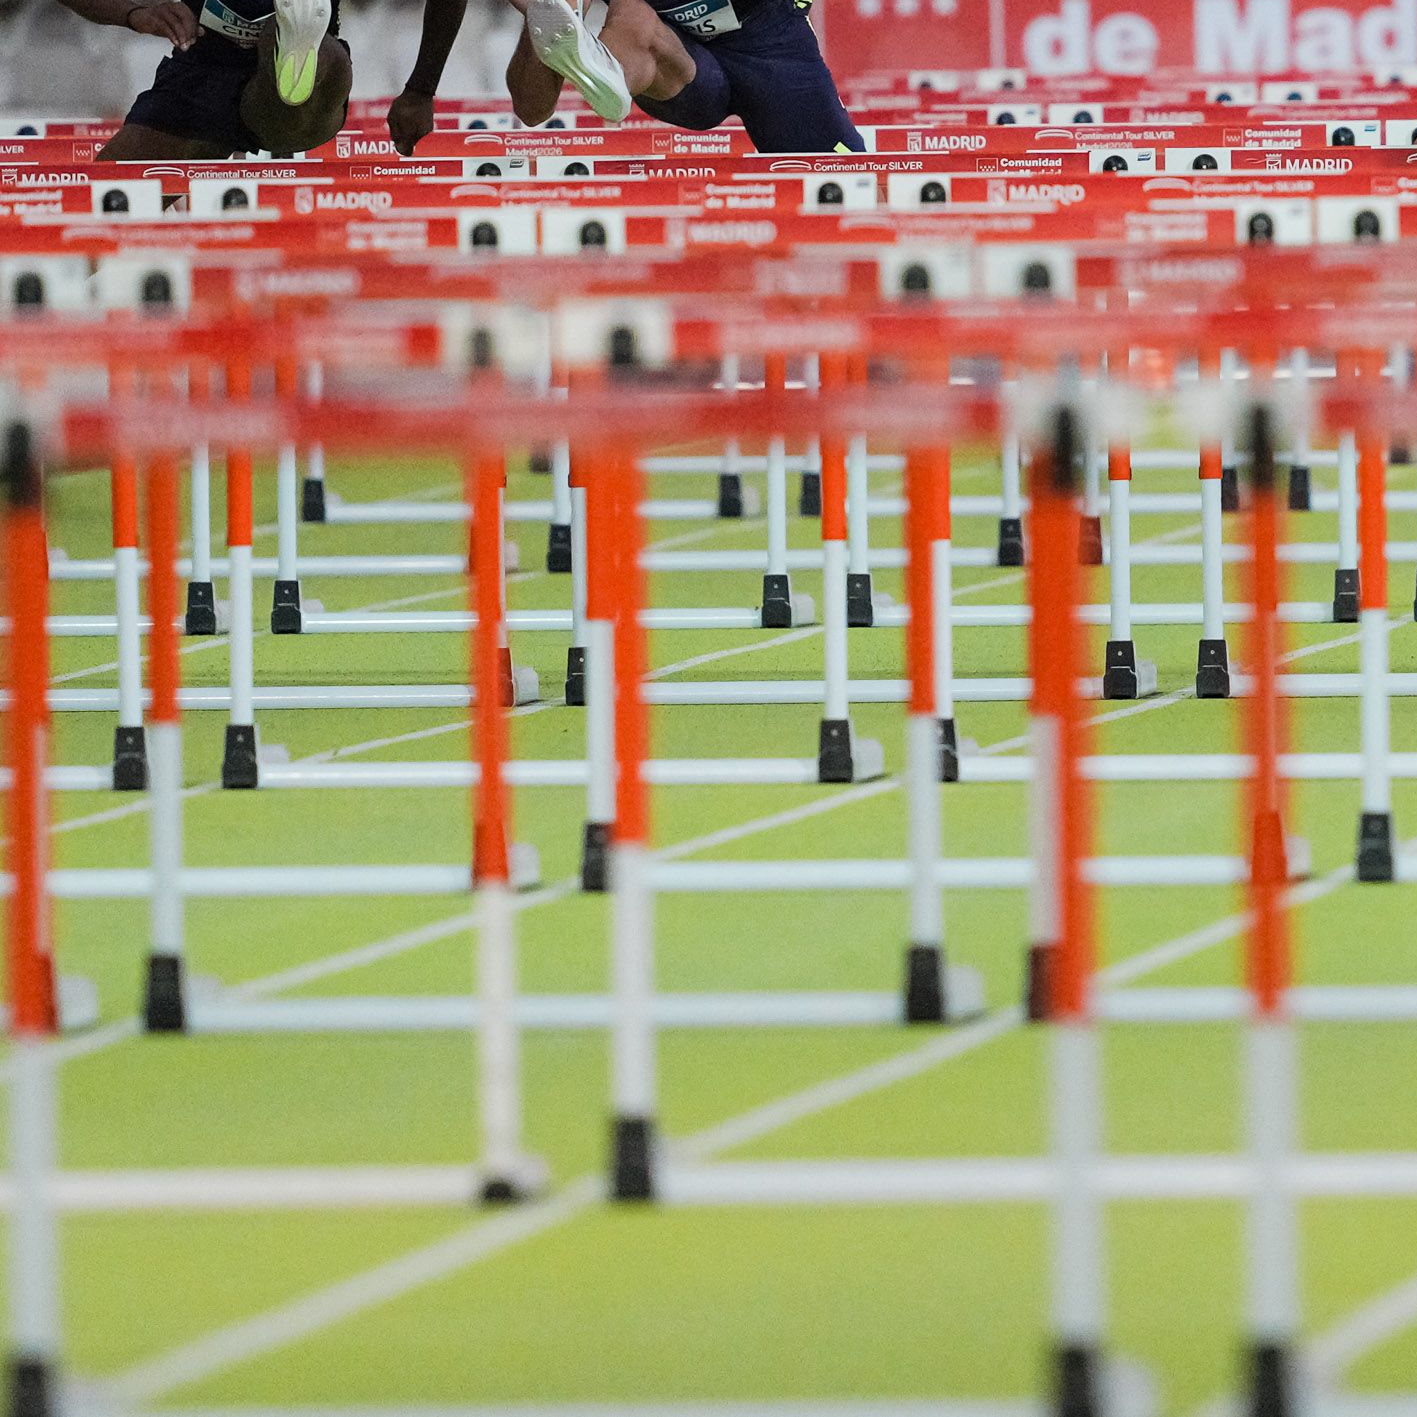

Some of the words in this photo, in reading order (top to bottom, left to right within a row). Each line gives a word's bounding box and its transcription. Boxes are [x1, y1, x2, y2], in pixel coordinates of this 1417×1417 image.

[674, 4, 708, 22] DRID
[674, 133, 730, 143] Comunidad
[1075, 130, 1123, 140] Continental
[1125, 130, 1141, 140] Tour
[1143, 130, 1174, 140] SILVER
[1245, 129, 1301, 138] Comunidad
[504, 136, 553, 146] Continental
[555, 136, 571, 146] Tour
[573, 136, 604, 145] SILVER
[925, 135, 986, 150] MADRID
[1245, 139, 1258, 147] de
[1261, 139, 1301, 147] Madrid
[674, 144, 687, 154] de
[691, 144, 730, 154] Madrid
[814, 162, 867, 172] Continental
[869, 162, 887, 171] Tour
[889, 161, 922, 170] SILVER
[1000, 158, 1062, 167] Comunidad
[1286, 158, 1352, 171] MADRID
[187, 169, 240, 179] Continental
[242, 169, 260, 179] Tour
[262, 169, 296, 178] SILVER
[374, 166, 435, 175] Comunidad
[649, 168, 716, 178] MADRID
[22, 173, 89, 184] MADRID
[1009, 185, 1085, 202] MADRID
[317, 192, 393, 210] MADRID
